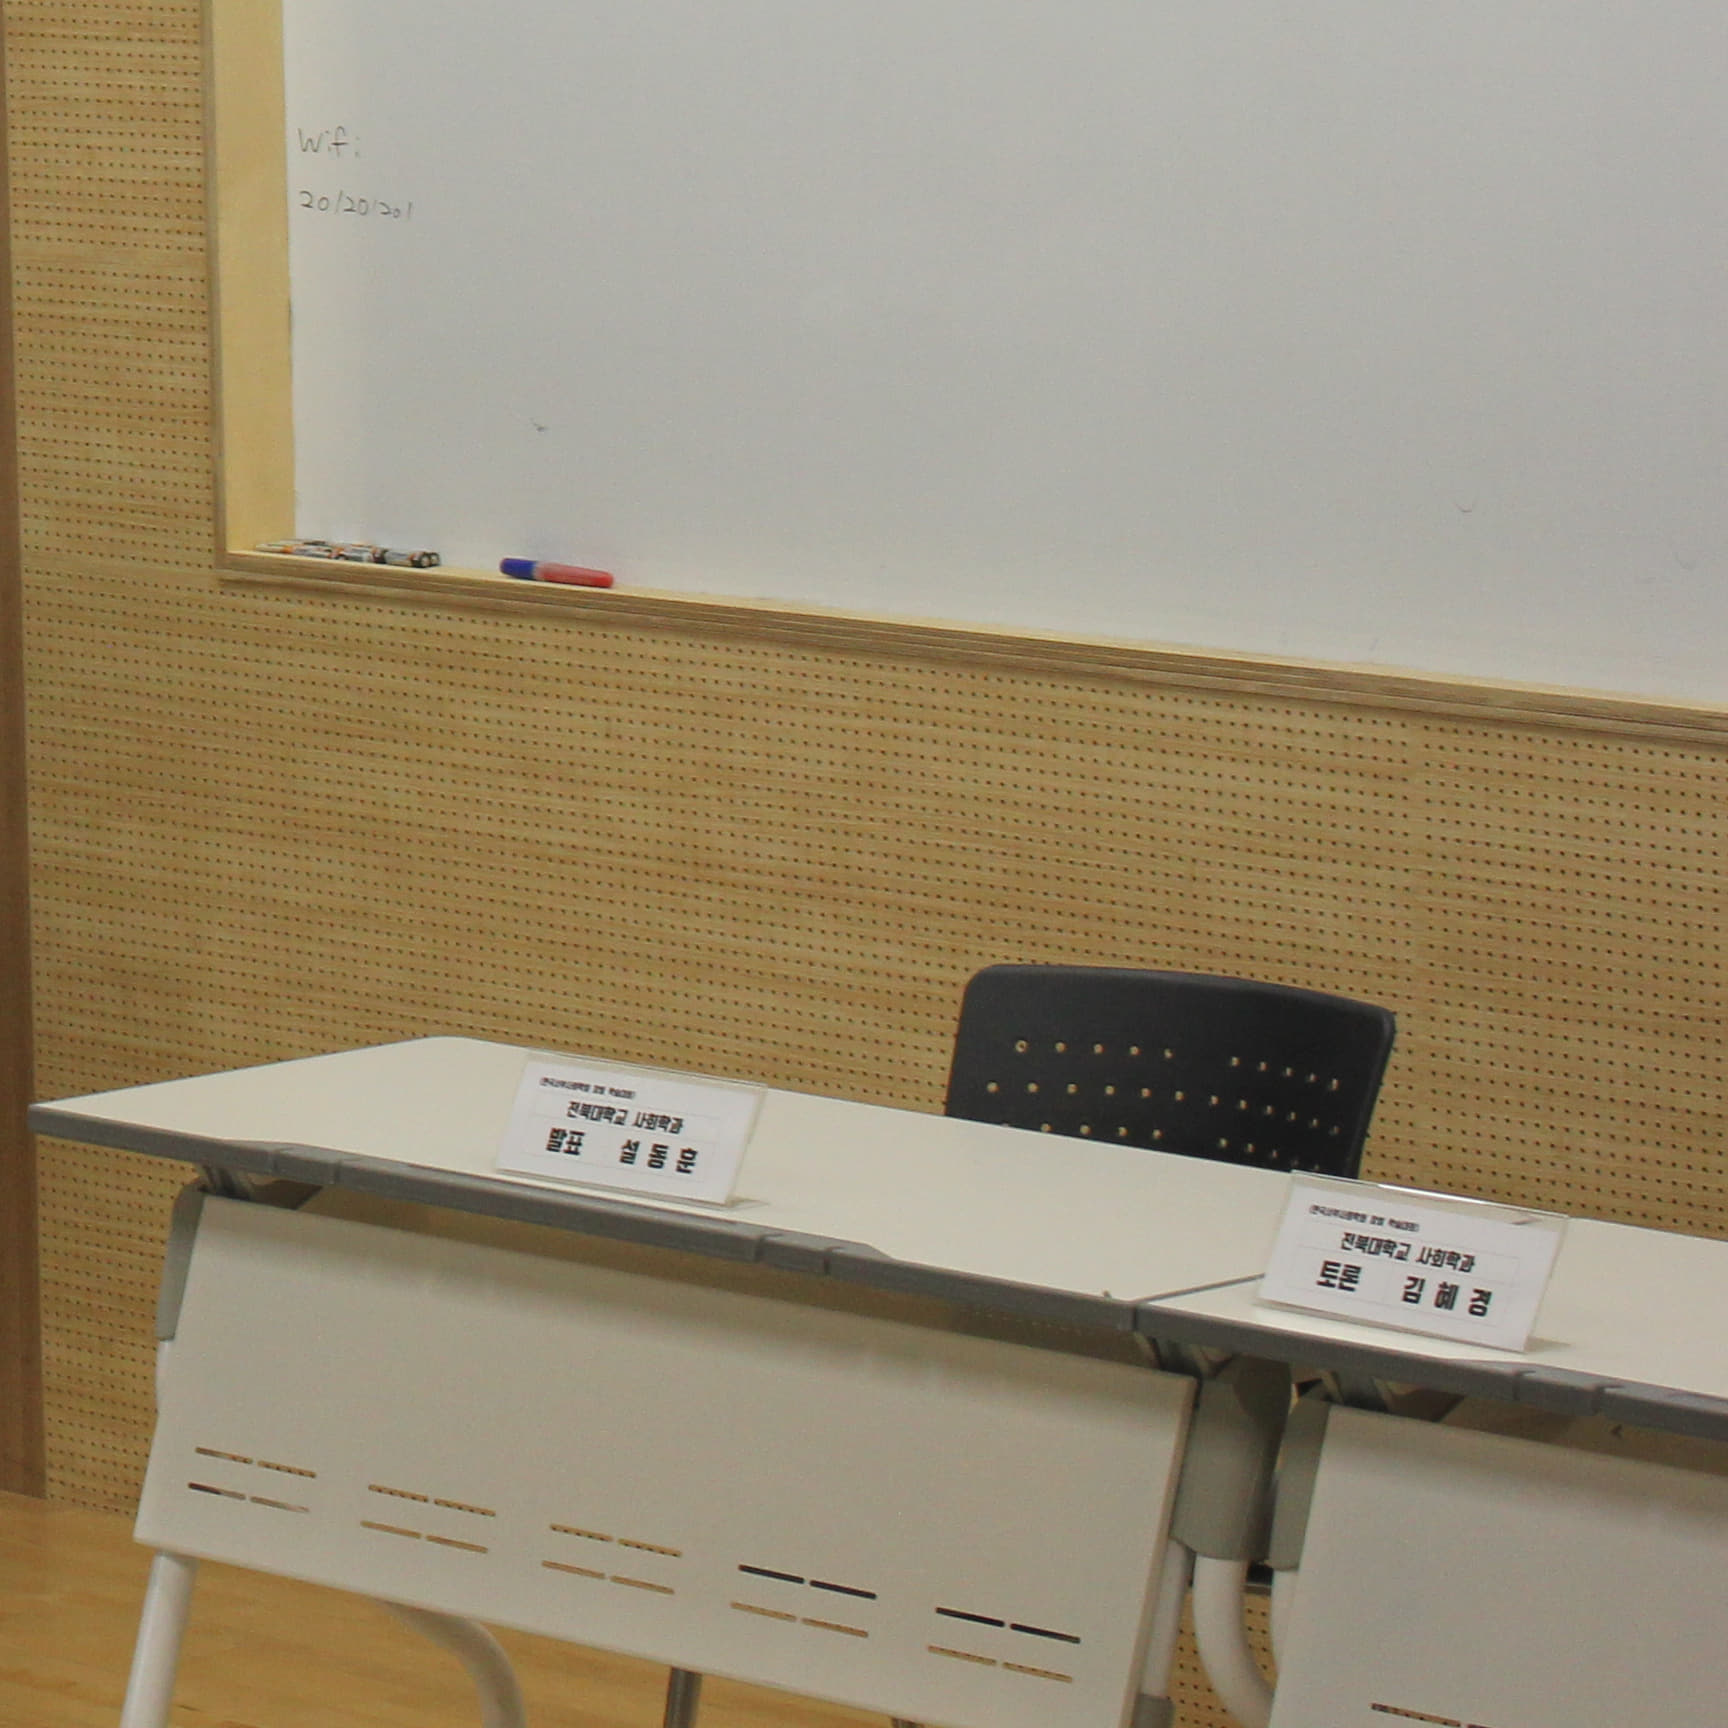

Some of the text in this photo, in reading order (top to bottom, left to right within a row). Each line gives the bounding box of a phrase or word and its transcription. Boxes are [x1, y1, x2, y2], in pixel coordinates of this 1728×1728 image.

[566, 1100, 684, 1135] 전북대학교 사회학과
[545, 1126, 586, 1156] 발표
[1341, 1231, 1476, 1274] 전북대학교 사회학과
[1316, 1259, 1363, 1292] 토론
